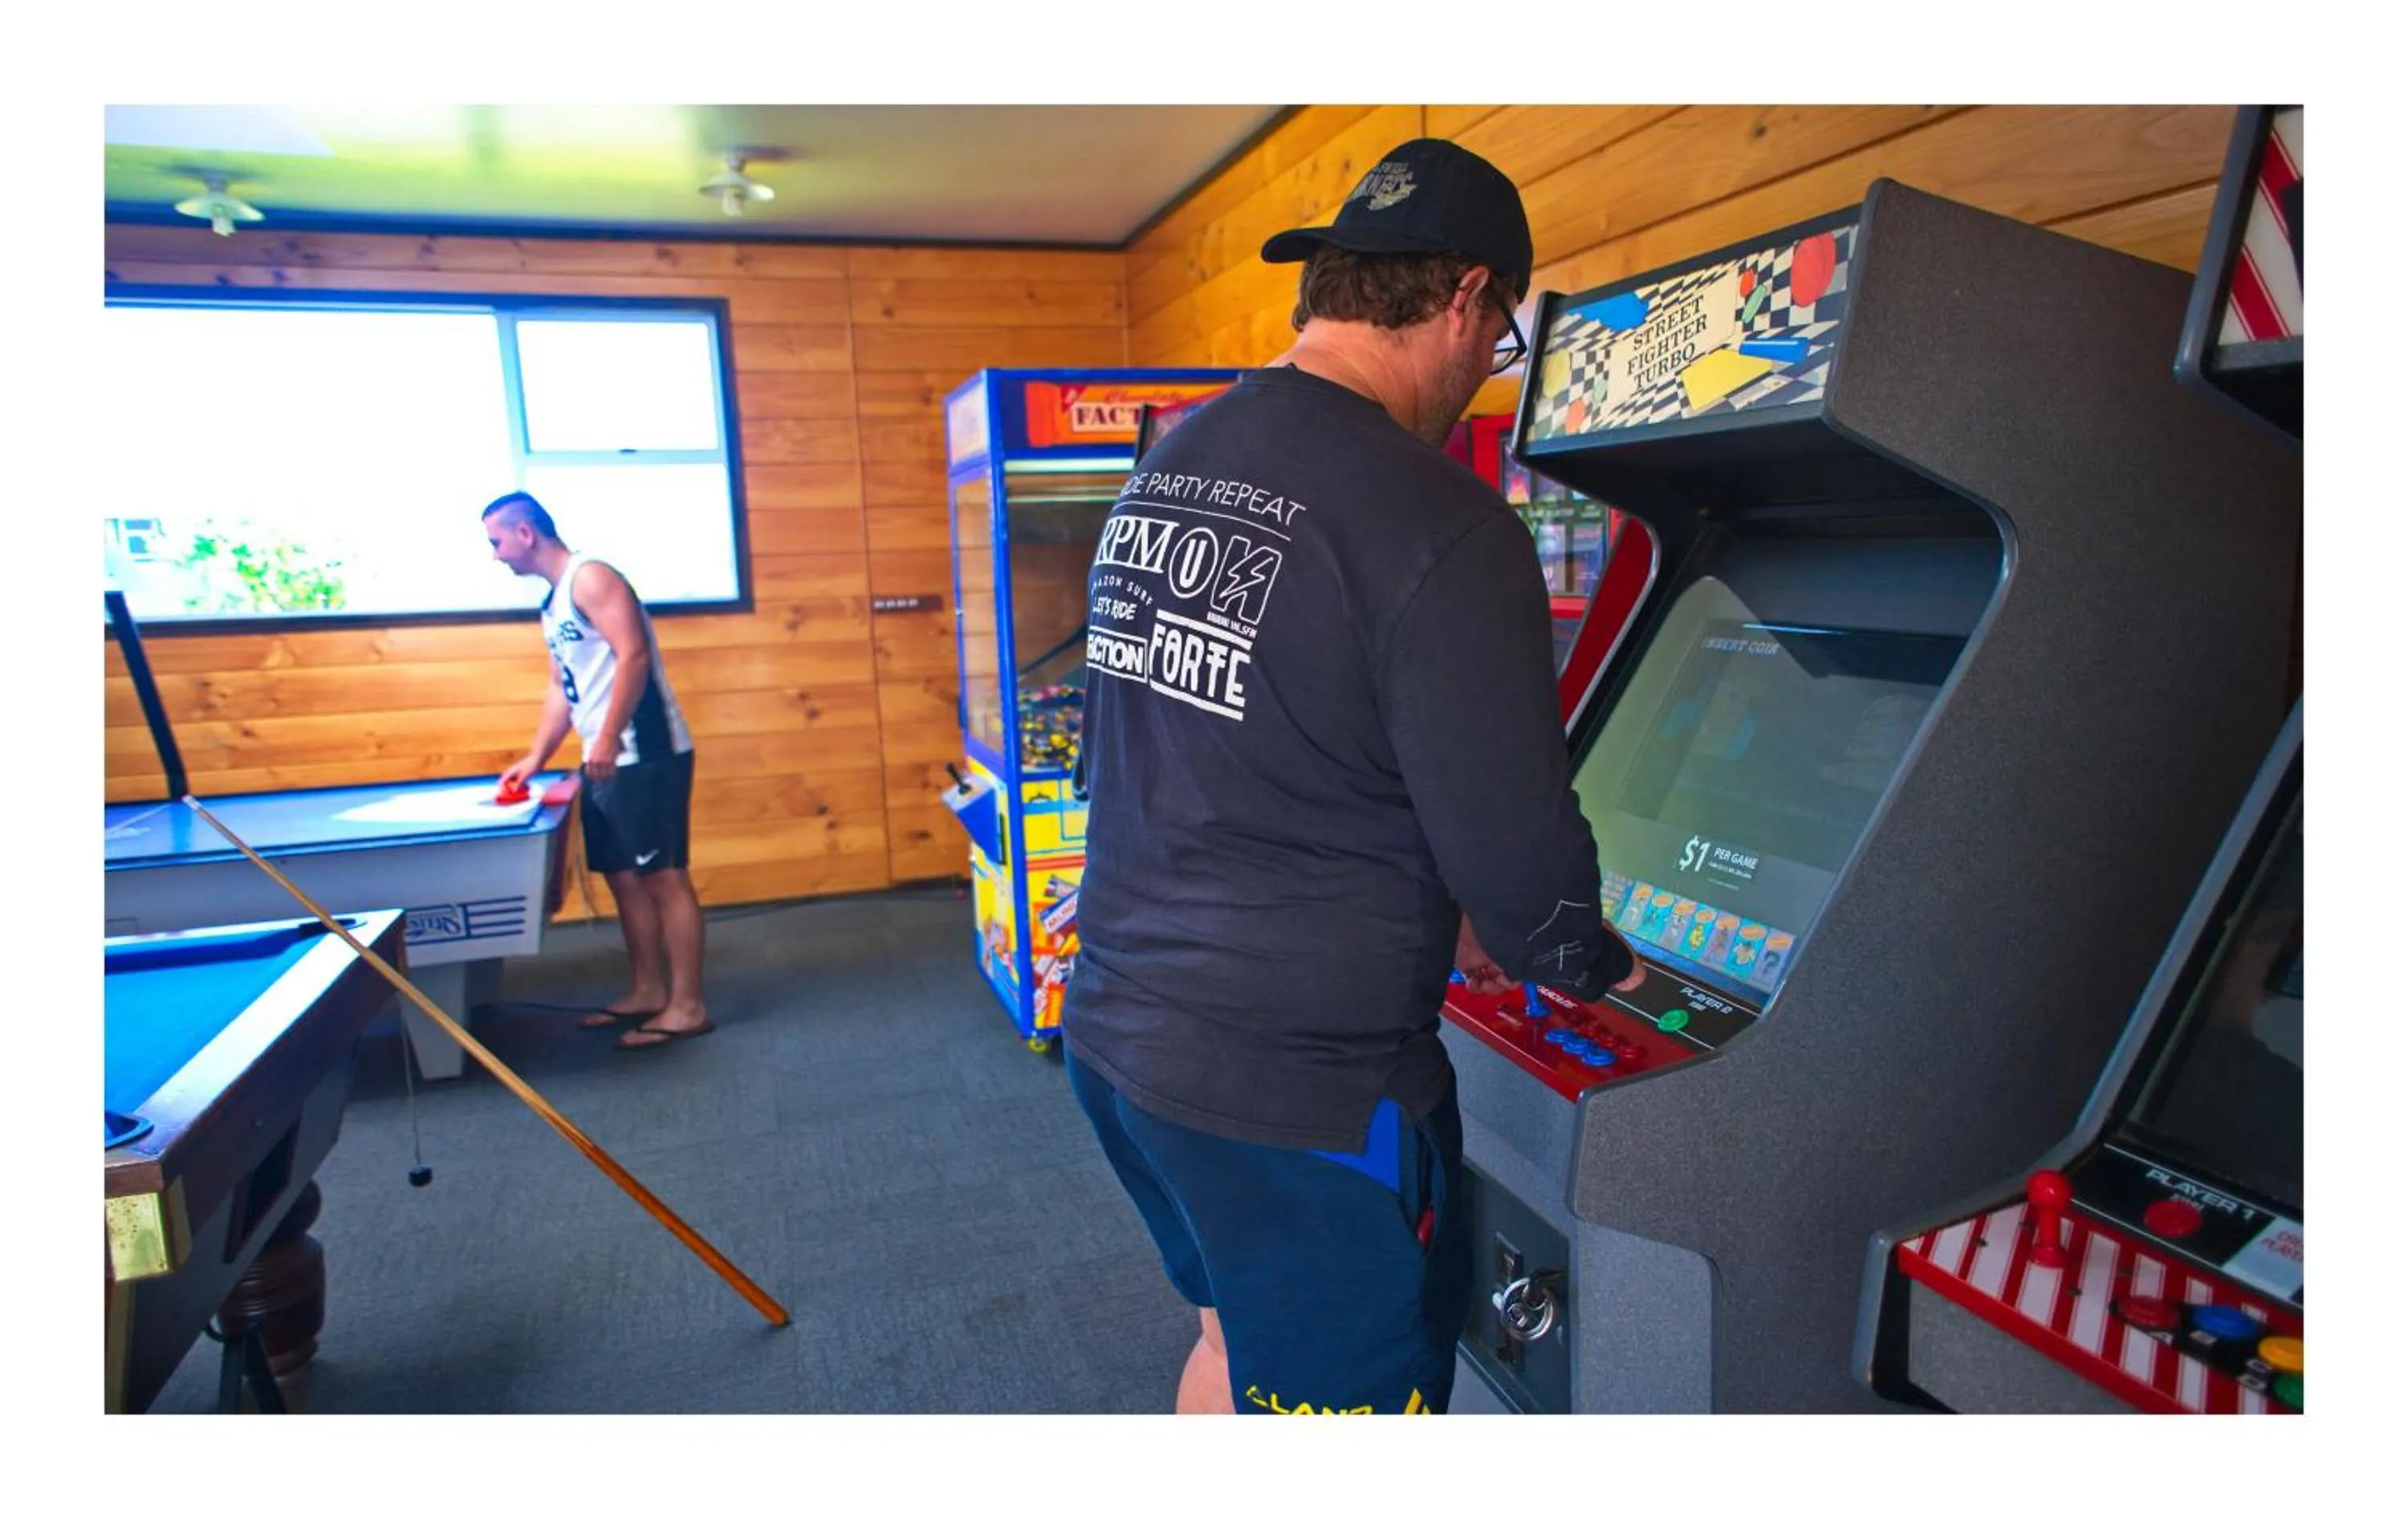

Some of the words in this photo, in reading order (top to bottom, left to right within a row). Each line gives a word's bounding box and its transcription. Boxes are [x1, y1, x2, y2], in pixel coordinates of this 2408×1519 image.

[1627, 314, 1707, 375] FIGHTER
[1633, 295, 1704, 351] STREET
[1633, 343, 1695, 391] TURBO
[1145, 472, 1210, 499] PARTY
[1207, 480, 1307, 525] REPEAT
[1095, 515, 1180, 574] RPM
[1126, 580, 1153, 607] SURF
[1149, 623, 1251, 708] FORTE
[1678, 835, 1710, 873] $1
[1714, 847, 1731, 861] PER
[1731, 853, 1759, 869] GAME
[1679, 987, 1723, 1009] PLAYER
[2146, 1168, 2239, 1214] PLAYER
[2242, 1208, 2255, 1221] 1
